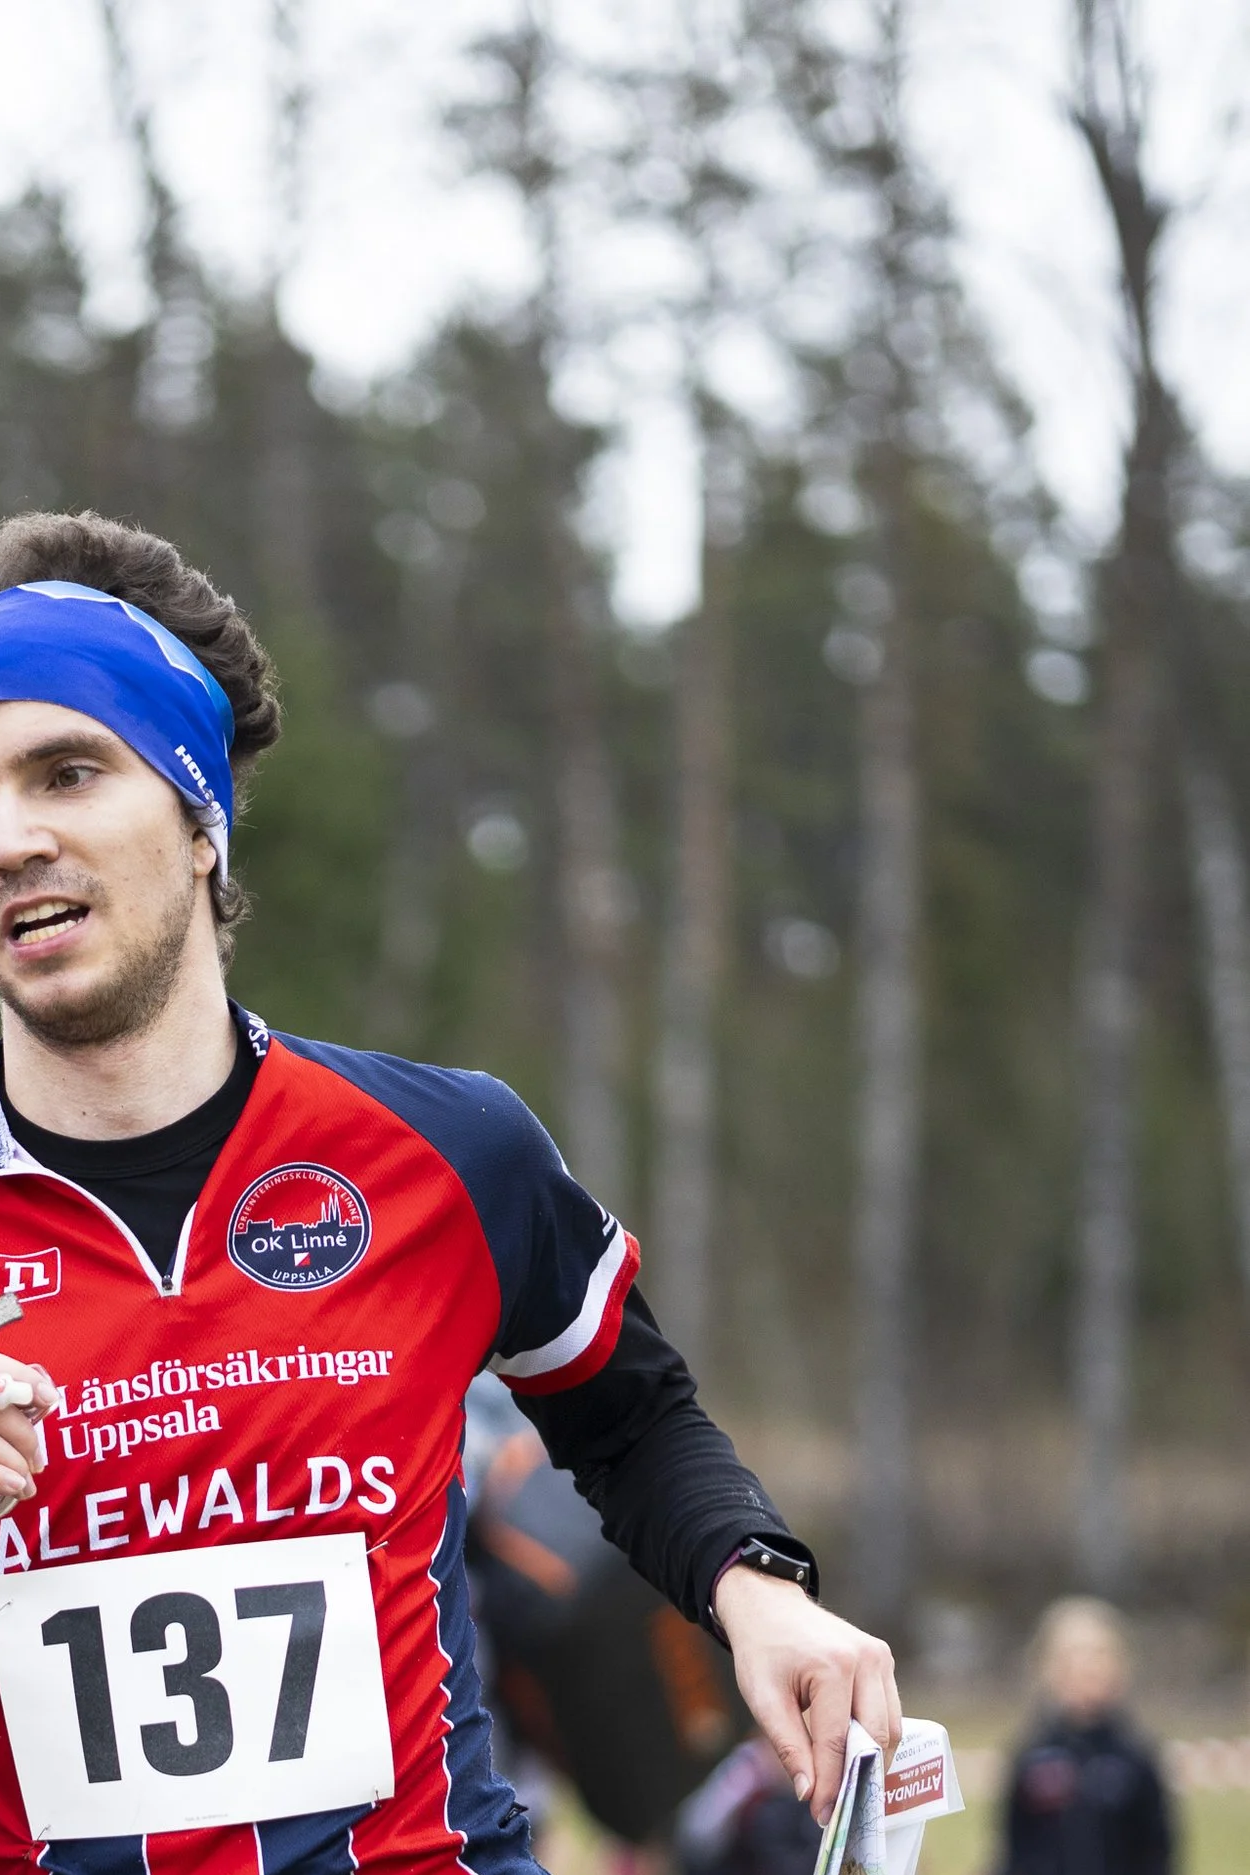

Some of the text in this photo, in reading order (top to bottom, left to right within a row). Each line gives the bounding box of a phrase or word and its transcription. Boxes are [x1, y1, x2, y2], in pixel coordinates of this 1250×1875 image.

[238, 1172, 360, 1230] ORIENTERINGSKLUBBEN LINNÉ
[251, 1230, 347, 1254] OK Linné
[272, 1266, 334, 1283] UPPSALA
[57, 1345, 393, 1420] Länsförsäkringar
[60, 1399, 222, 1463] Uppsala
[41, 1581, 327, 1784] 137
[884, 1772, 942, 1804] ATTUNDA
